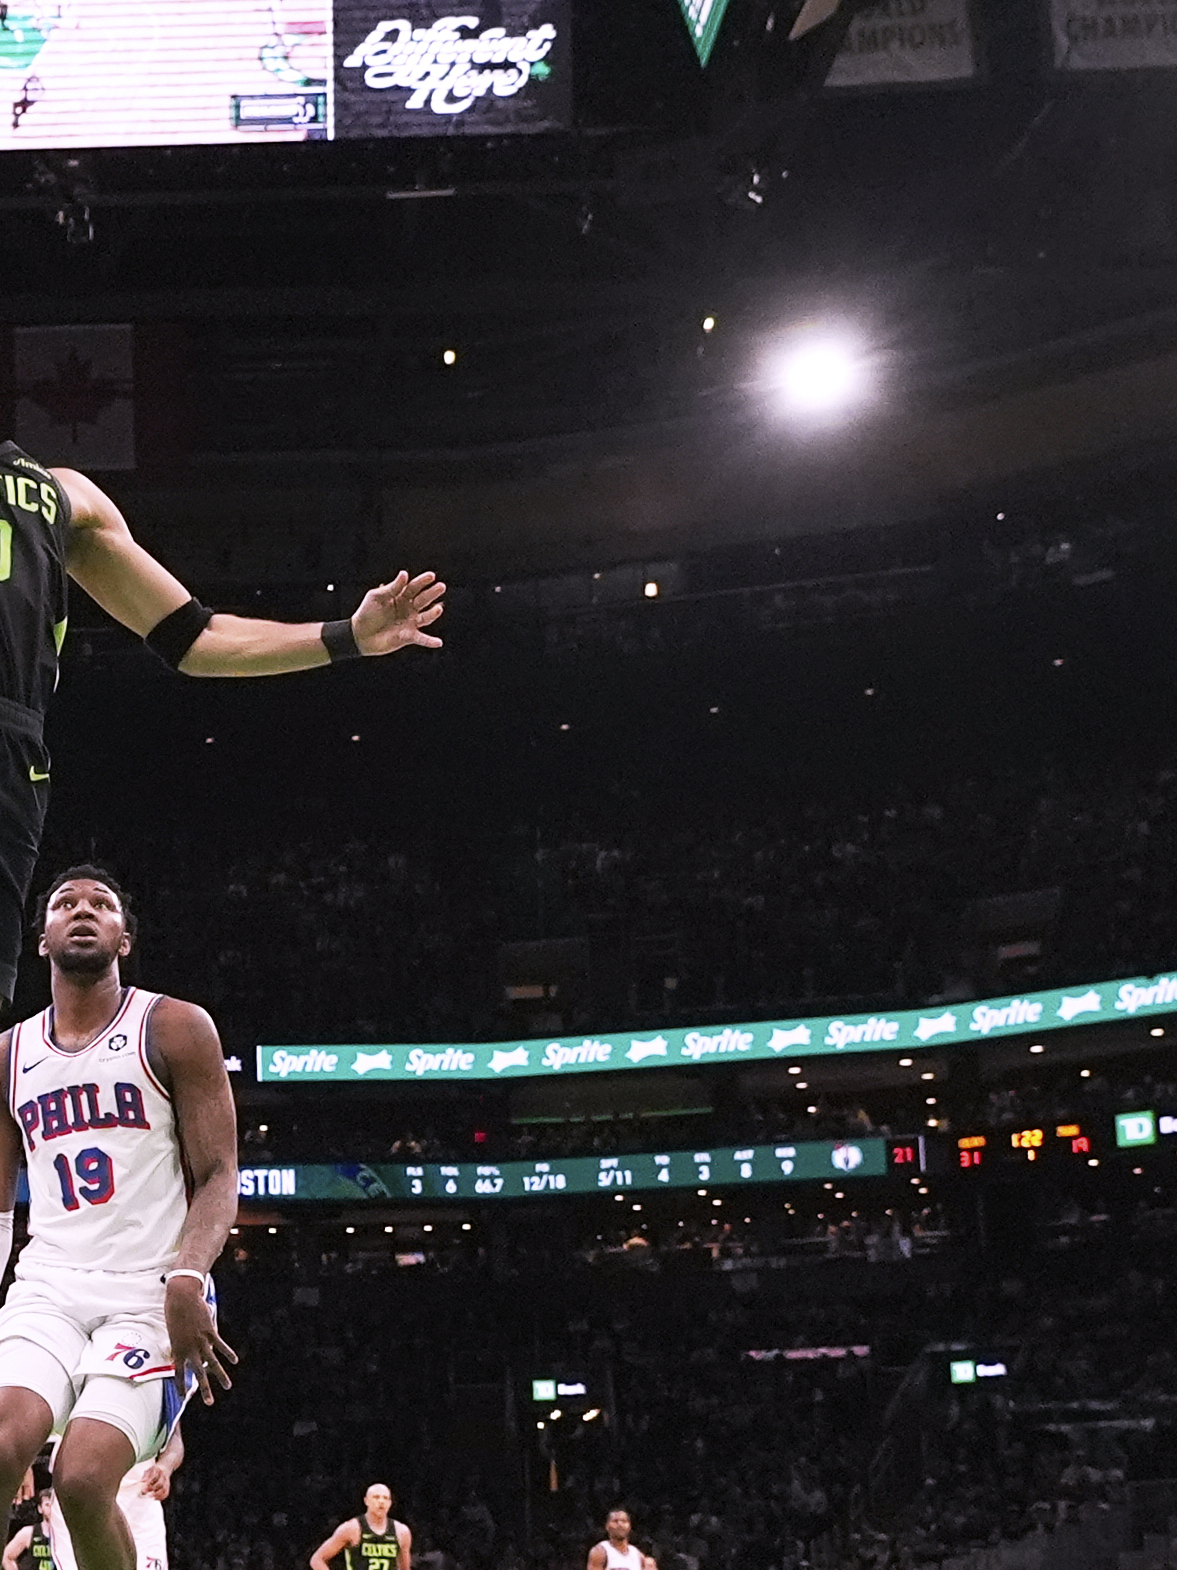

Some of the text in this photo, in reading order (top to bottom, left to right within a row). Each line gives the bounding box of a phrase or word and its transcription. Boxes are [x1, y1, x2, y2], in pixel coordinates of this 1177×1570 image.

[268, 1049, 339, 1077] Sprite
[404, 1048, 476, 1076] Sprite
[541, 1040, 612, 1070] Sprite
[681, 1028, 754, 1060] Sprite
[824, 1016, 900, 1050] Sprite
[969, 998, 1043, 1034] Sprite
[17, 1082, 151, 1152] PHILA
[893, 1147, 913, 1163] 21
[960, 1151, 980, 1167] 31
[54, 1147, 115, 1211] 19
[237, 1169, 295, 1196] STON
[411, 1179, 422, 1194] 3
[445, 1179, 457, 1194] 6
[597, 1169, 632, 1187] 5/11
[657, 1168, 670, 1183] 4
[698, 1165, 710, 1181] 3
[104, 1342, 151, 1369] 76
